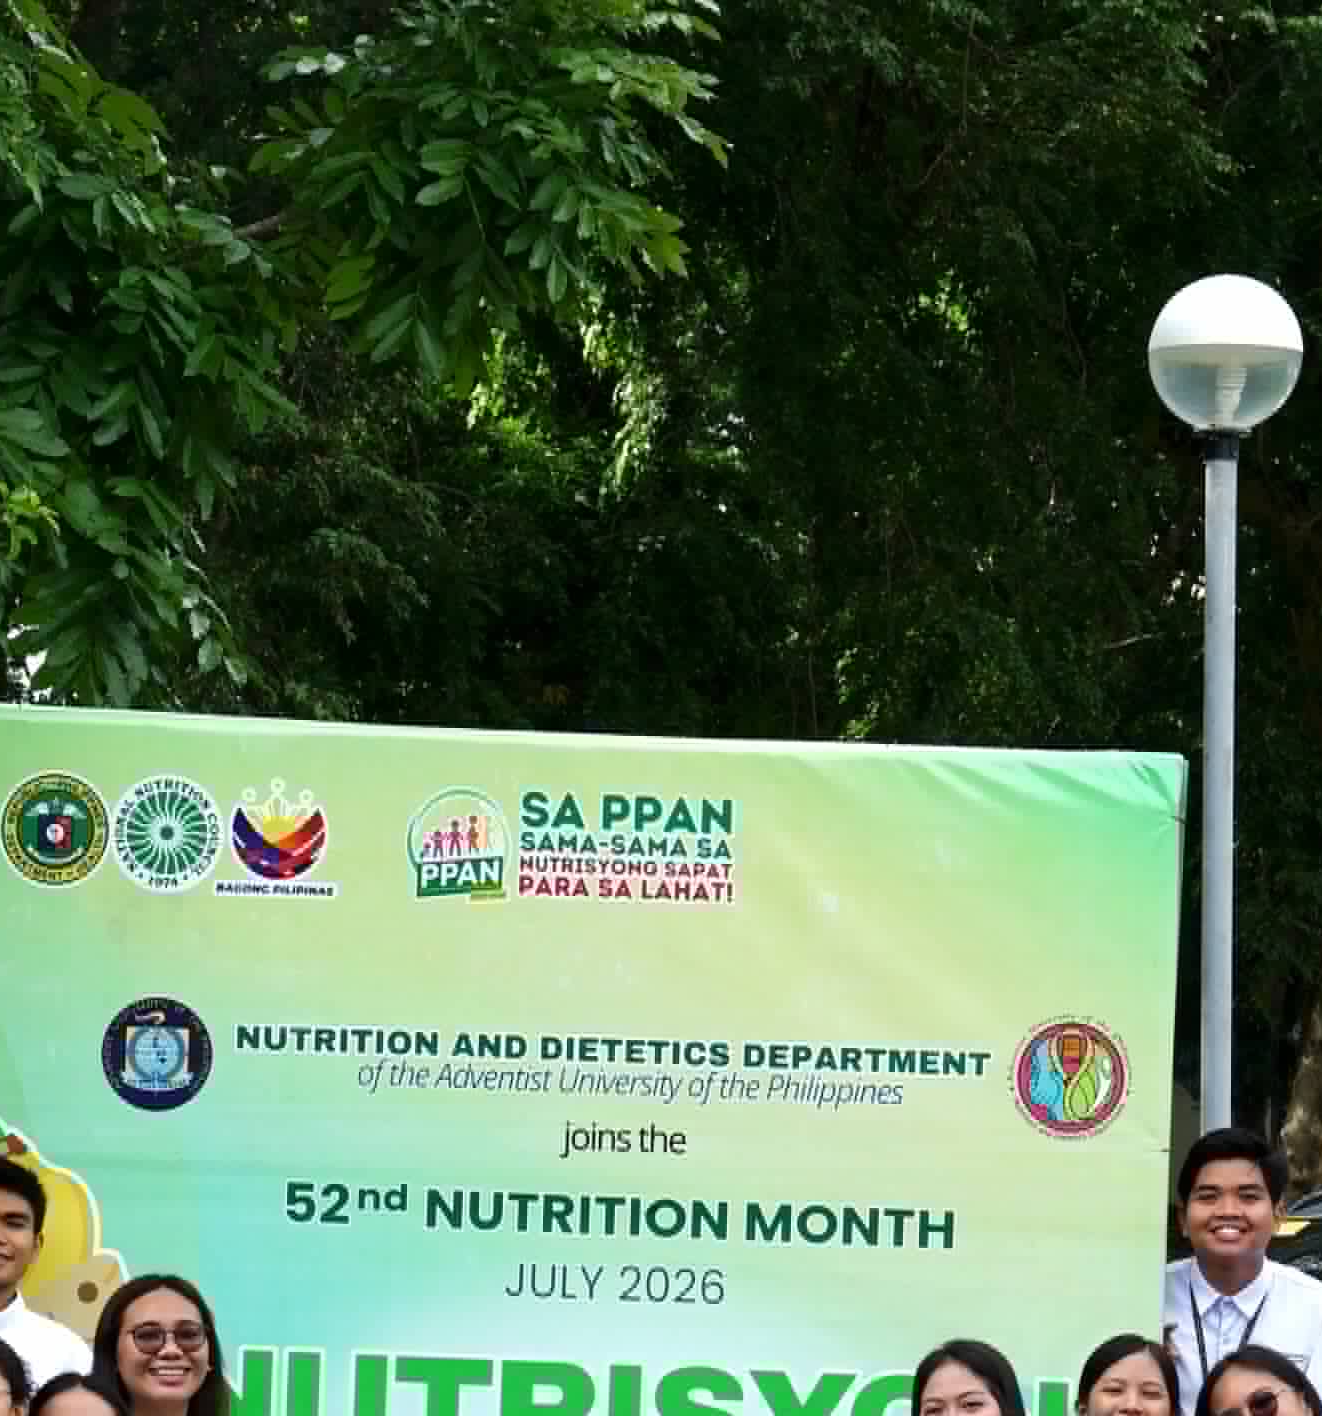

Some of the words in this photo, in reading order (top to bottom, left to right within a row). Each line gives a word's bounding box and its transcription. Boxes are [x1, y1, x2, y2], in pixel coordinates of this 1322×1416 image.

[521, 791, 584, 829] SA
[601, 794, 732, 834] PPAN
[520, 832, 687, 858] SAMA-SAMA
[697, 838, 731, 859] SA
[422, 861, 500, 888] PPAN
[519, 876, 589, 898] PARA
[598, 879, 632, 898] SA
[641, 880, 733, 903] LAHAT!
[664, 862, 733, 879] SAPAT
[236, 1025, 439, 1056] NUTRITION
[452, 1032, 527, 1059] AND
[540, 1037, 729, 1068] DIETETICS
[743, 1043, 992, 1077] DEPARTMENT
[357, 1058, 388, 1096] of
[390, 1058, 430, 1088] the
[435, 1061, 552, 1093] Adventist
[559, 1066, 681, 1104] University
[687, 1070, 719, 1106] of
[720, 1070, 760, 1101] the
[766, 1073, 904, 1112] Philippines
[559, 1121, 632, 1158] joins
[638, 1123, 688, 1154] the
[285, 1181, 408, 1225] 52nd
[425, 1187, 728, 1241] NUTRITION
[745, 1202, 955, 1250] MONTH
[504, 1261, 605, 1301] JULY
[618, 1265, 727, 1306] 2026
